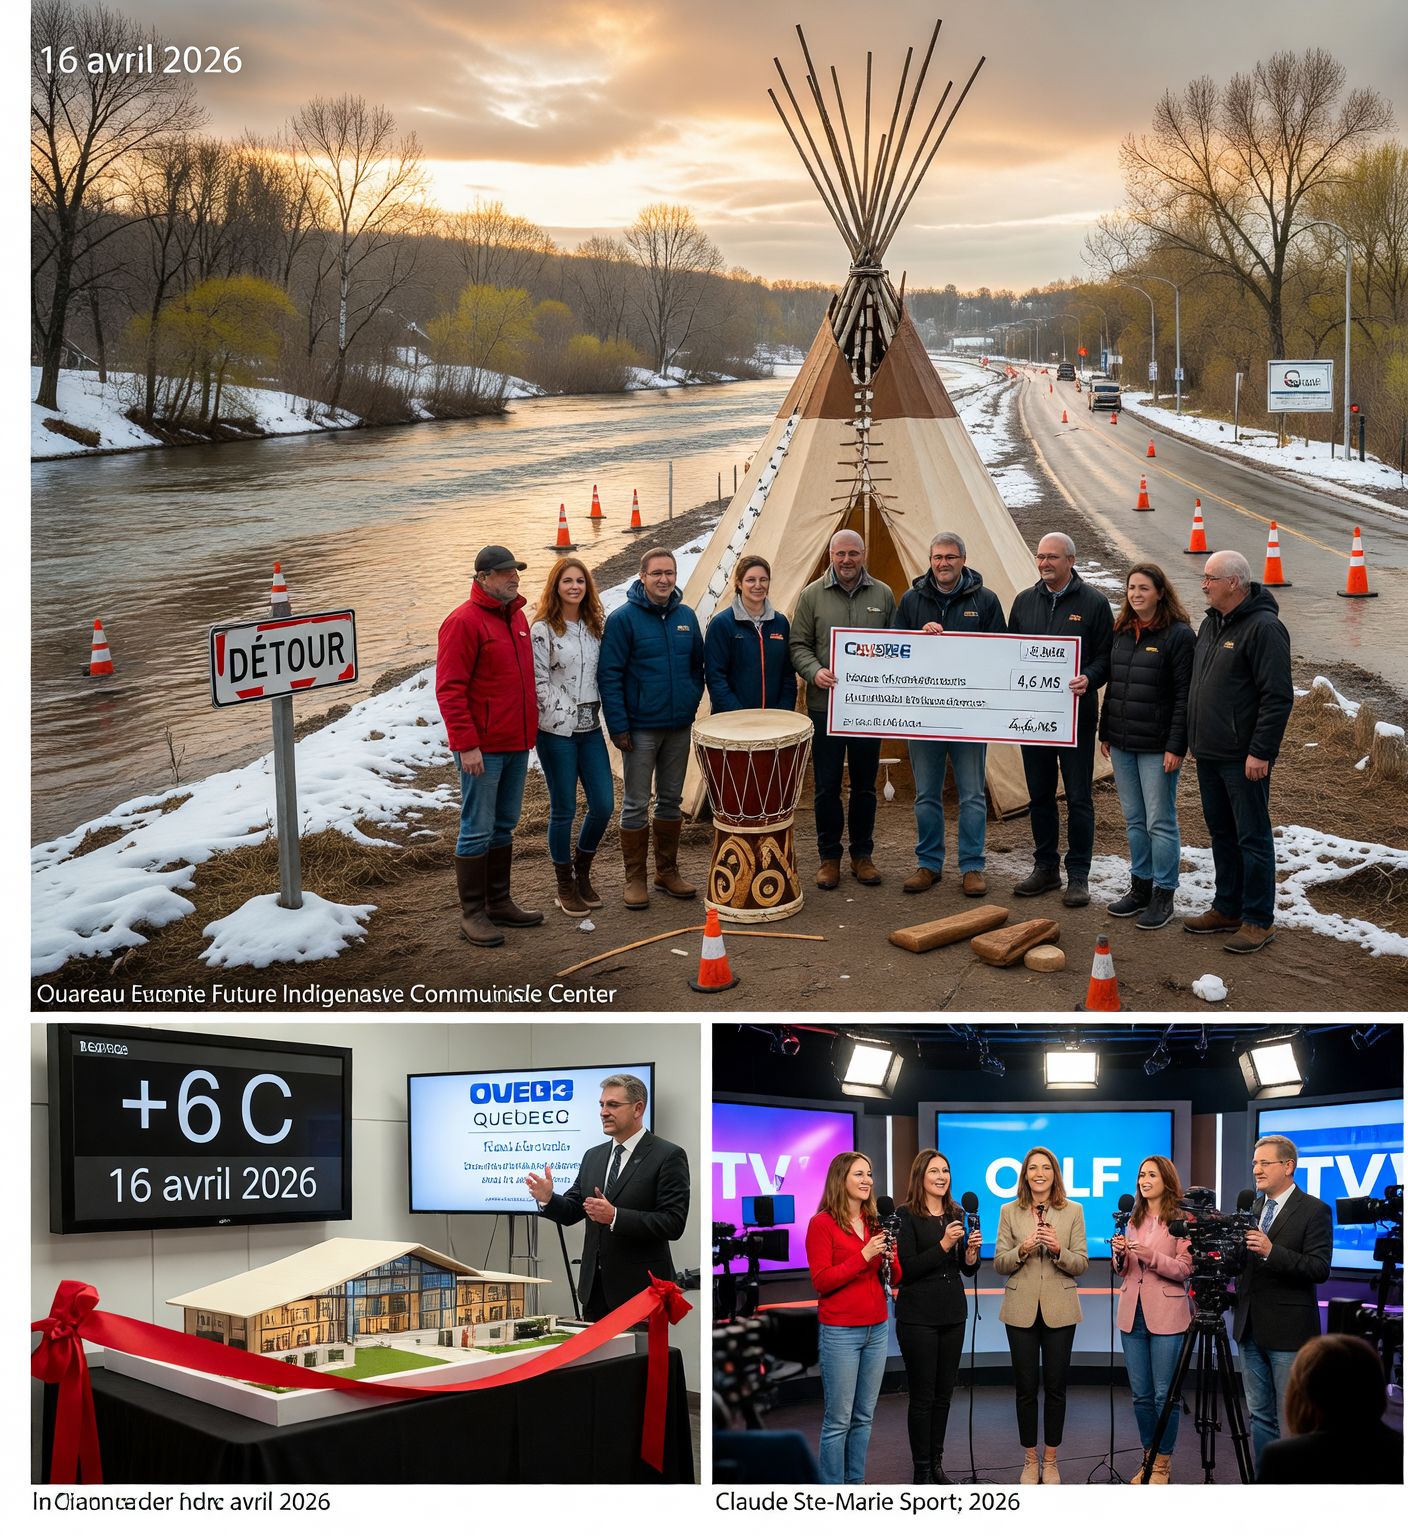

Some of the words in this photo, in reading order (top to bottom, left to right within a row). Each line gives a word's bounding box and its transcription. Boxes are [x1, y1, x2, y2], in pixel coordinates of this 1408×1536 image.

[230, 632, 345, 684] DÉTOUR
[1018, 675, 1037, 689] 4,6
[241, 1073, 293, 1144] C
[110, 1167, 151, 1203] 16
[162, 1167, 230, 1201] avril
[242, 1166, 317, 1199] 2026
[985, 1157, 1122, 1198] OLF
